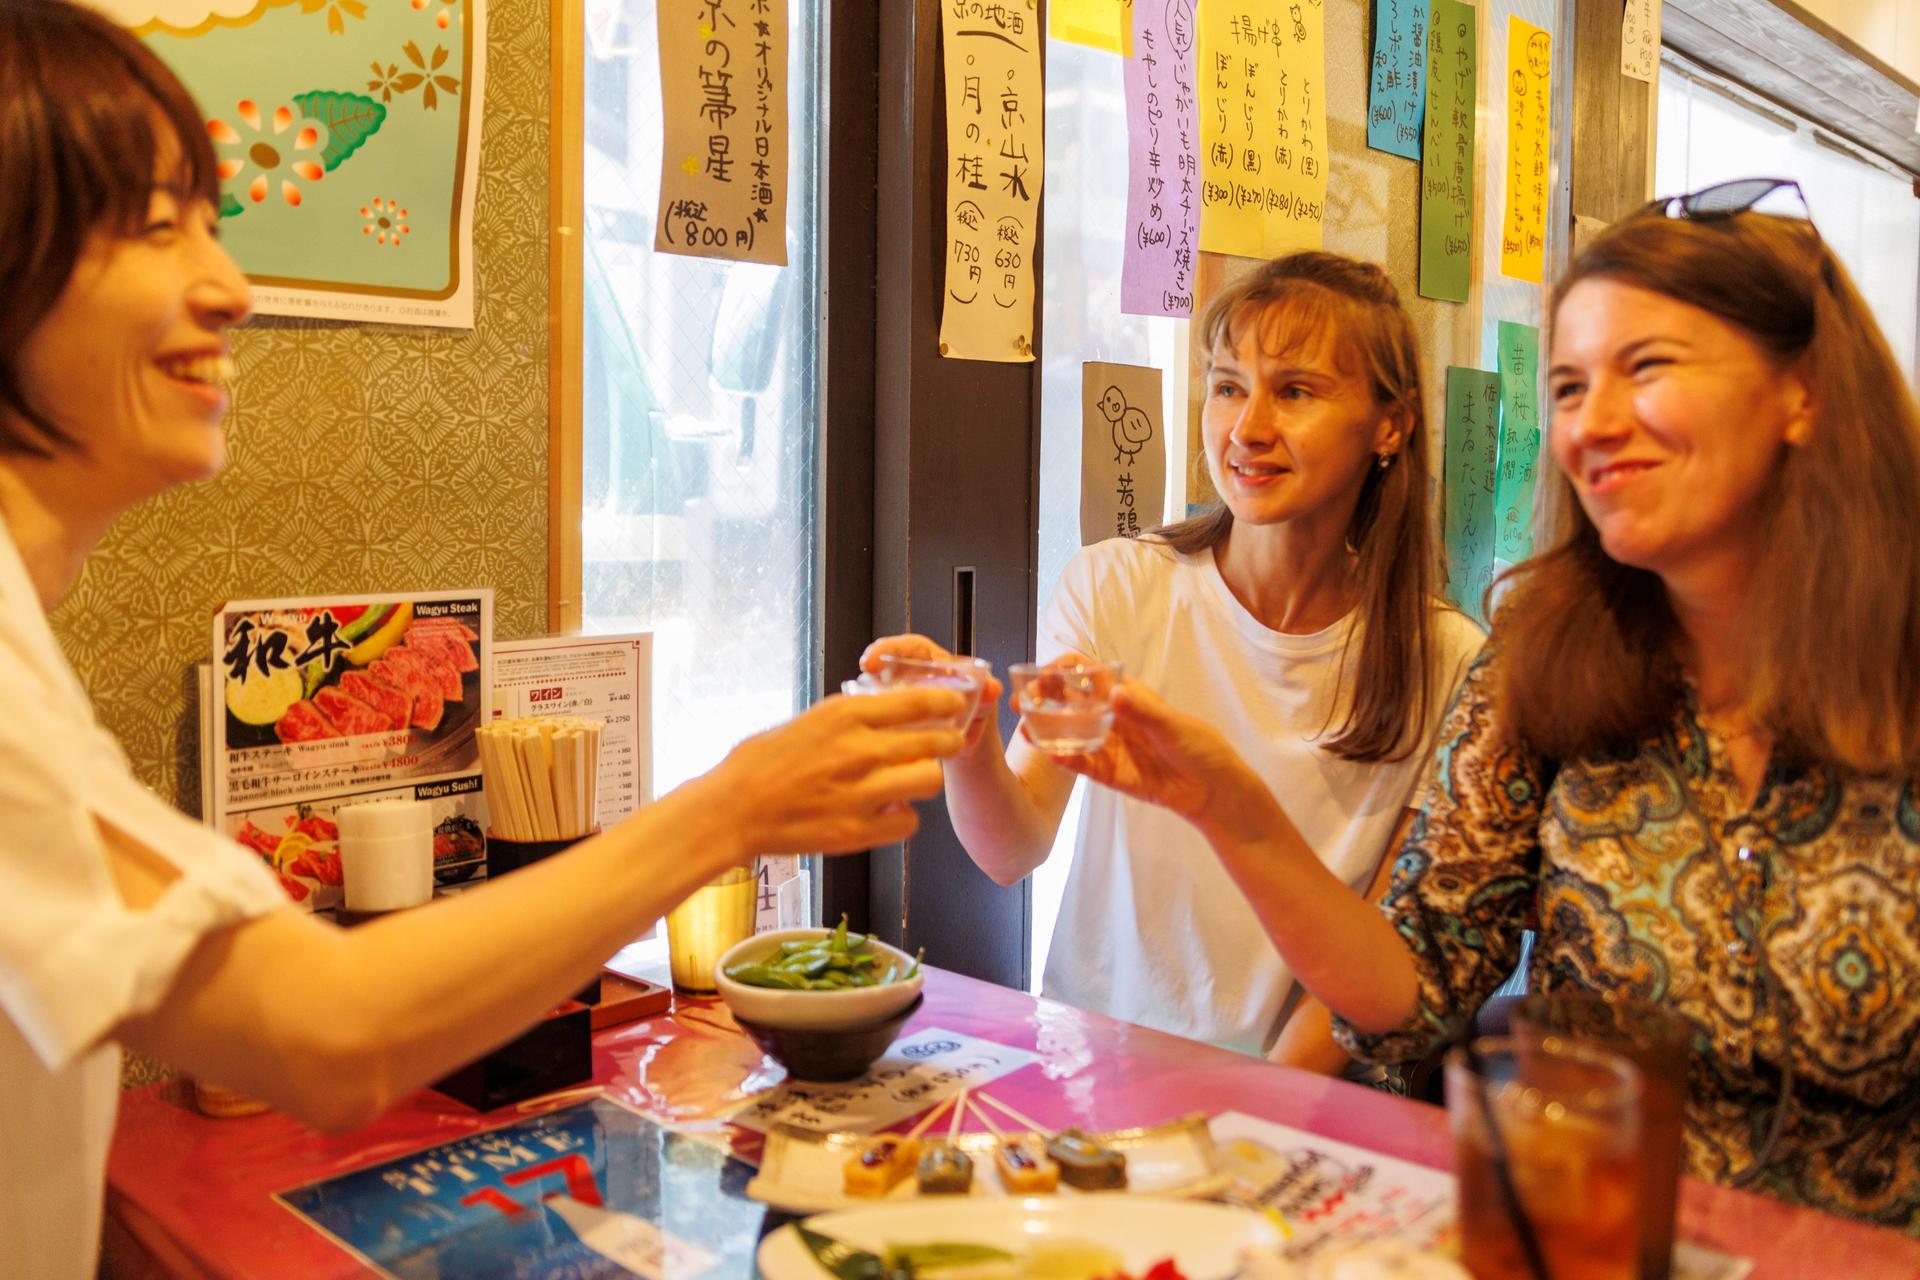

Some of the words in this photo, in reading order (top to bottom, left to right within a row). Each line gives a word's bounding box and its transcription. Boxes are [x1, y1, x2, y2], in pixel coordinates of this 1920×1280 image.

[416, 604, 448, 617] Wagyu
[449, 602, 478, 614] Steak
[222, 611, 352, 685] 和牛
[530, 687, 562, 702] ワイン
[417, 785, 450, 798] Wagyu
[451, 778, 478, 792] Sushi
[402, 1131, 585, 1196] TIME
